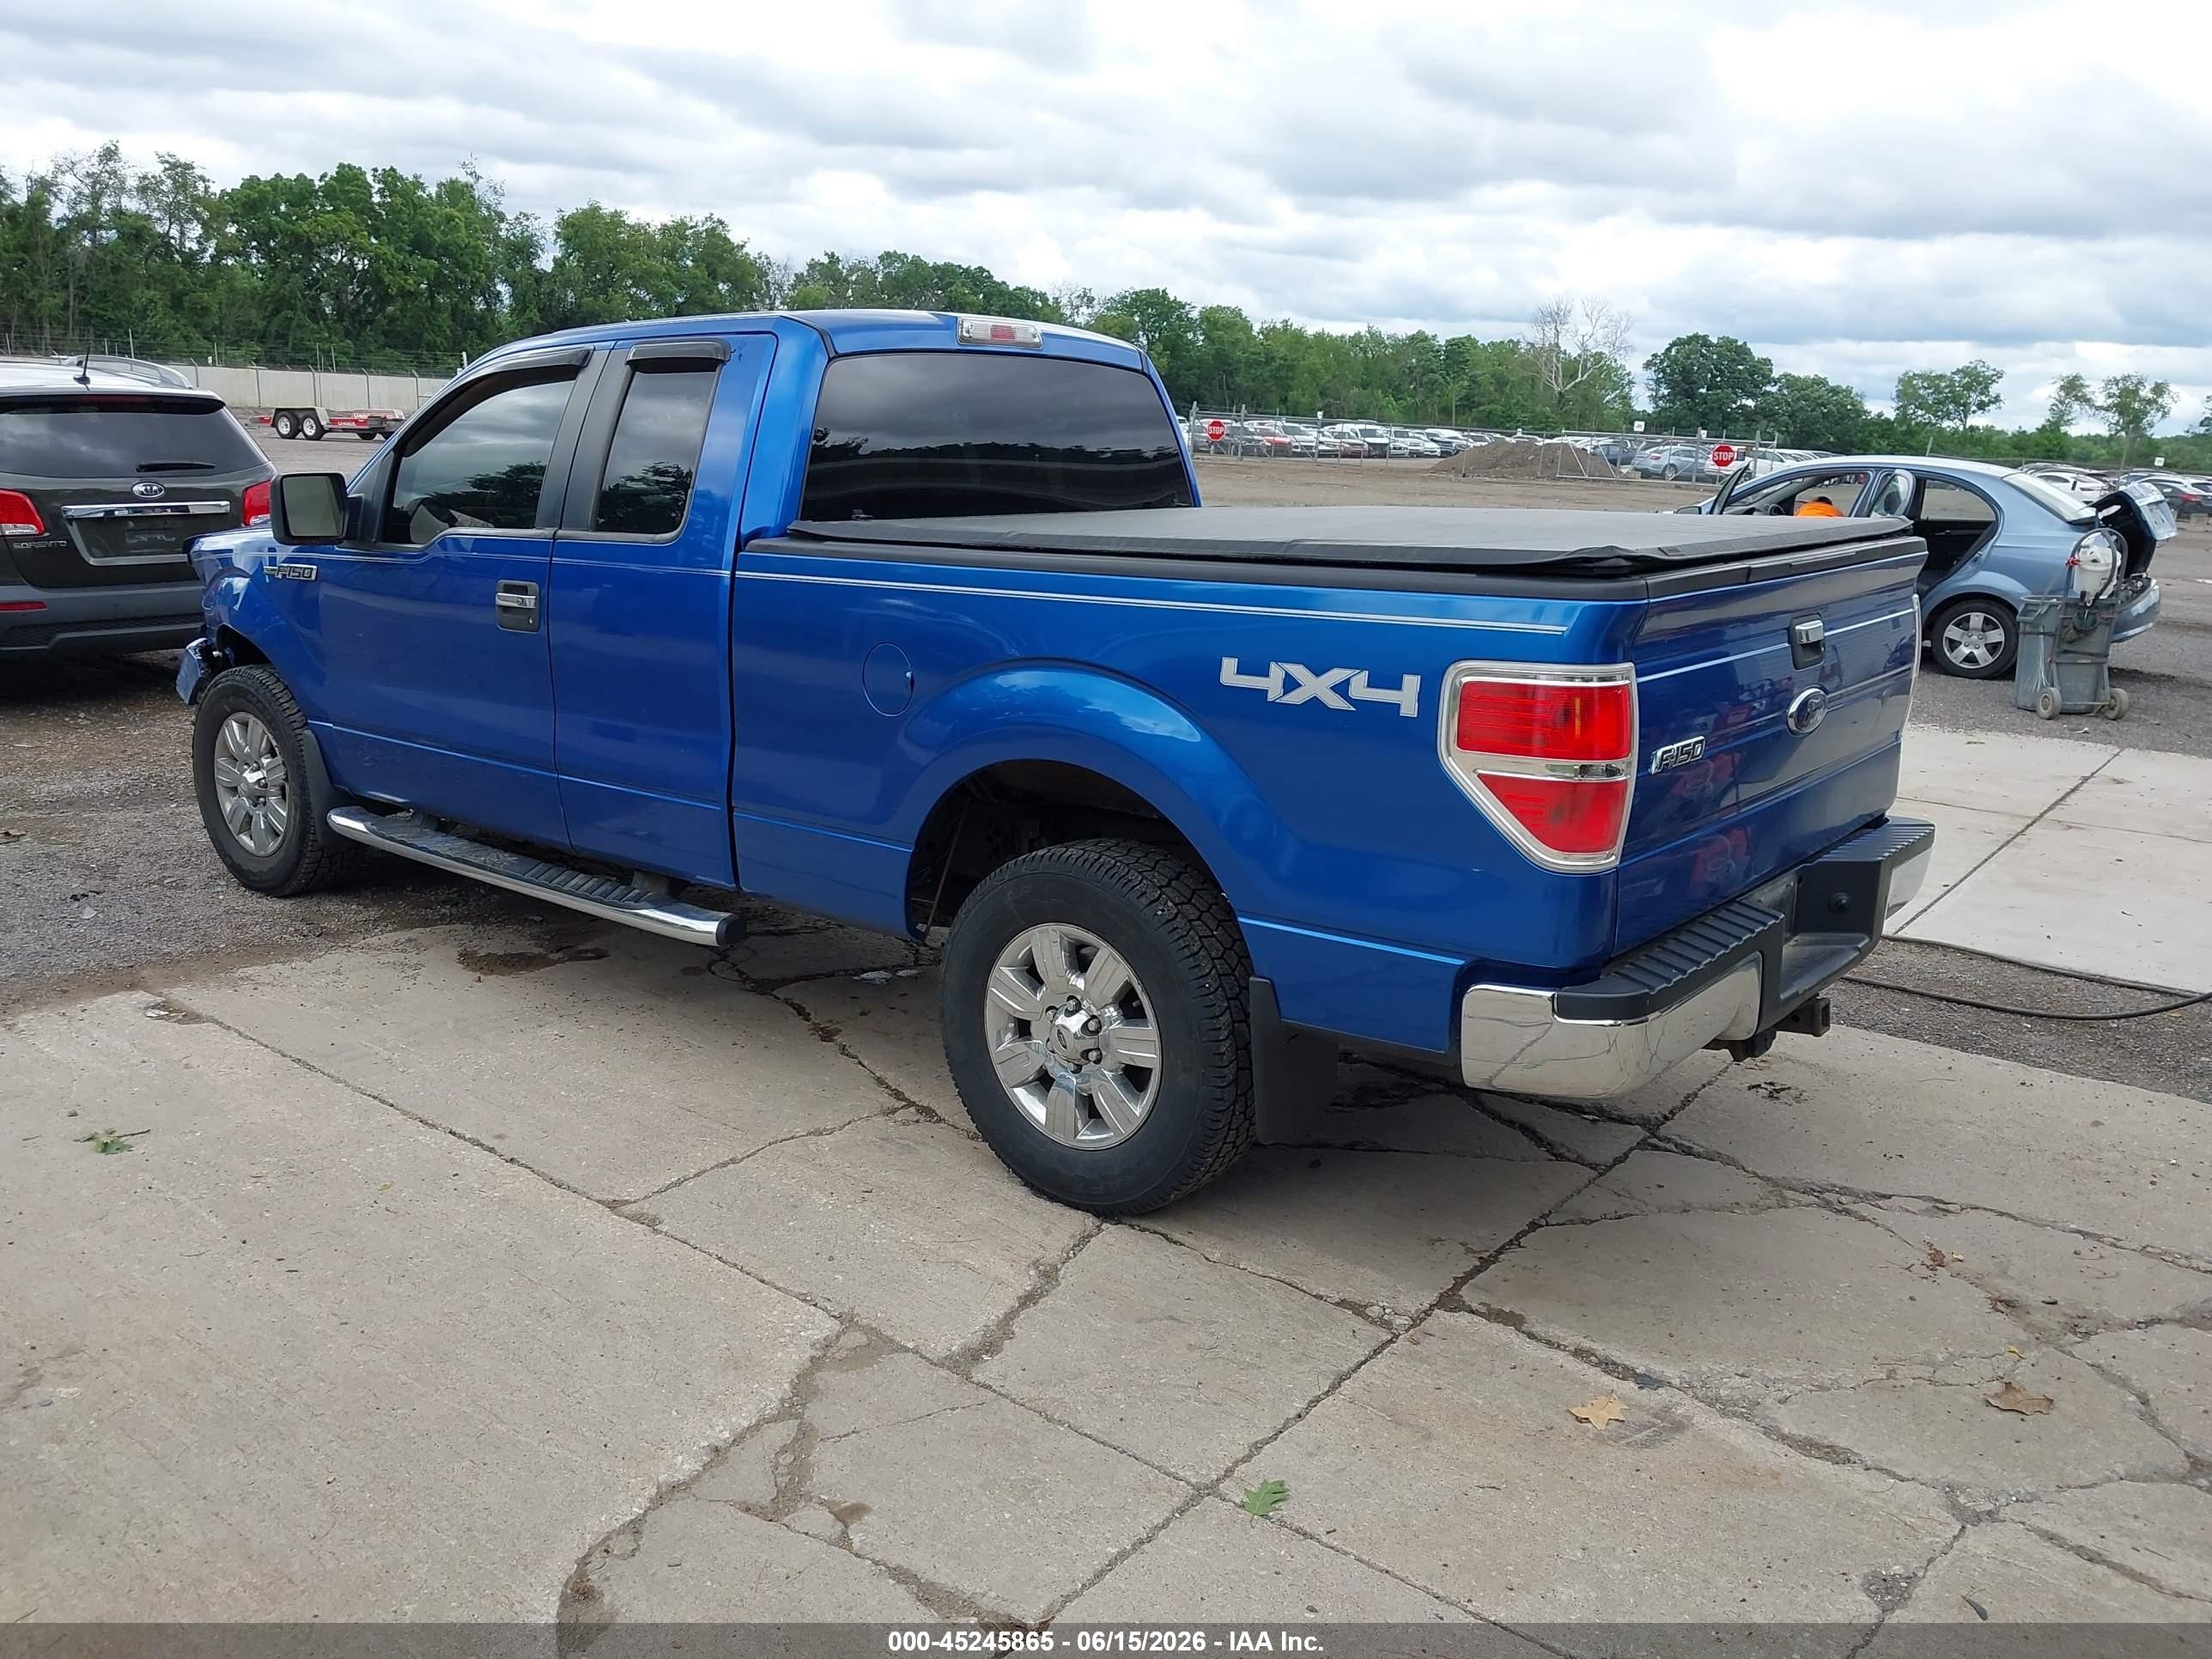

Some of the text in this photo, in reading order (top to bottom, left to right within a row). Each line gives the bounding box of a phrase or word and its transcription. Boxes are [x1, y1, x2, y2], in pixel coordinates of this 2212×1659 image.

[1208, 426, 1224, 434] STOP
[1713, 452, 1735, 461] STOP
[135, 483, 163, 496] KIA
[13, 540, 68, 550] SORENTO
